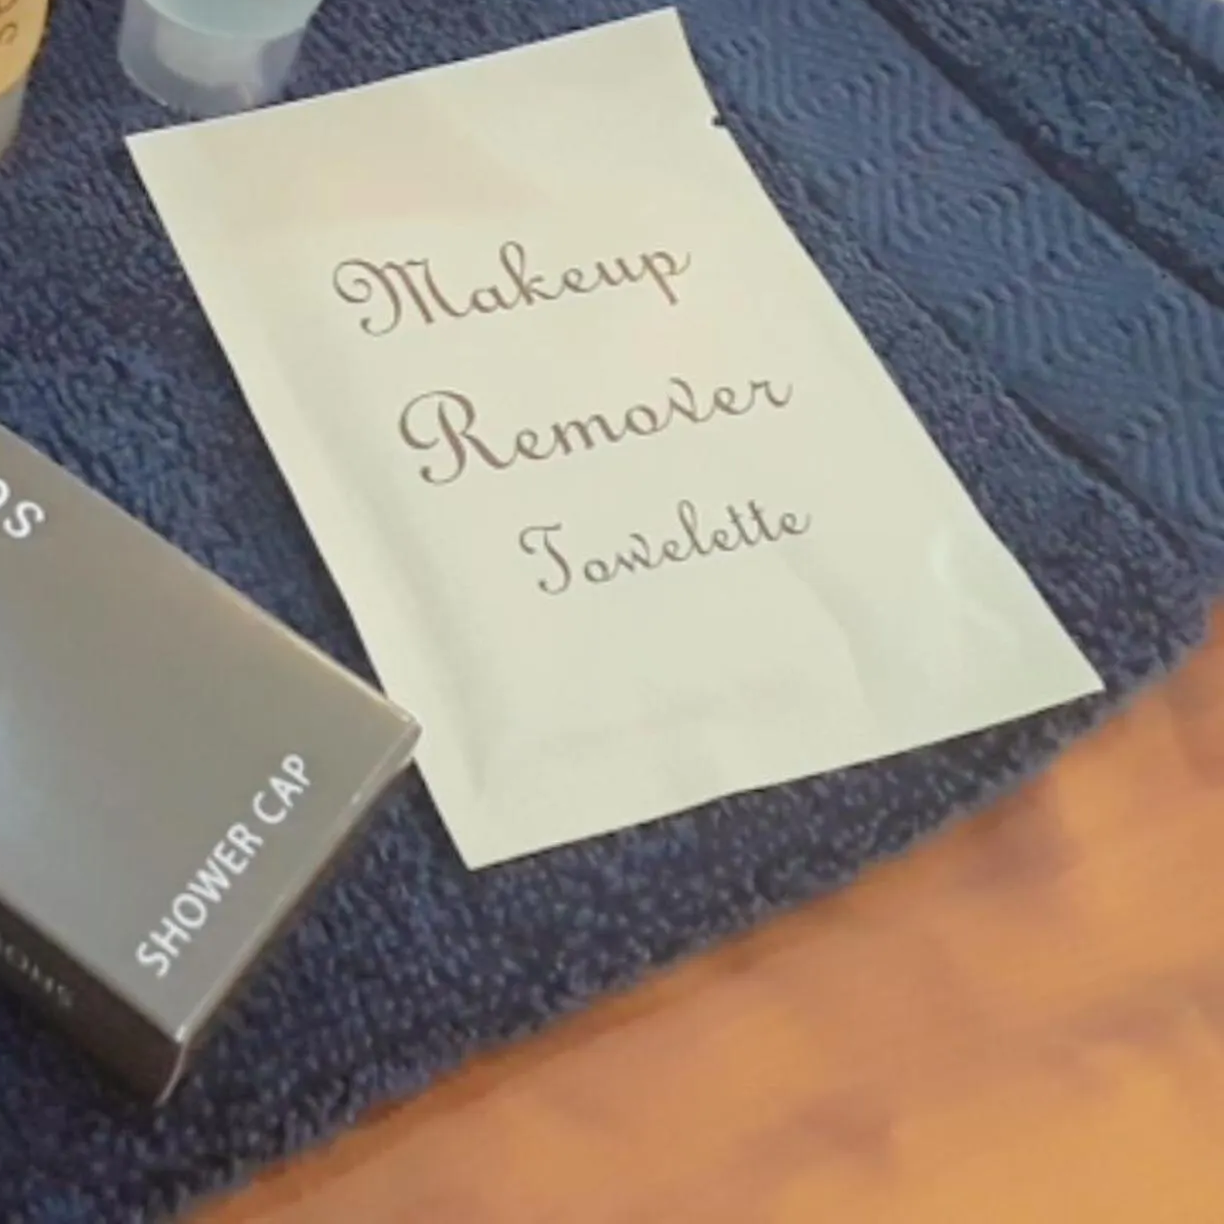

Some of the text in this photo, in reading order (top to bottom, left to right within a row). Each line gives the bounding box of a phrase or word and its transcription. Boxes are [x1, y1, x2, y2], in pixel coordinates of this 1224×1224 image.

[332, 240, 692, 337] Makeup
[397, 375, 794, 486] Remover
[518, 499, 812, 597] Towelette
[135, 752, 313, 980] SHOWER CAP
